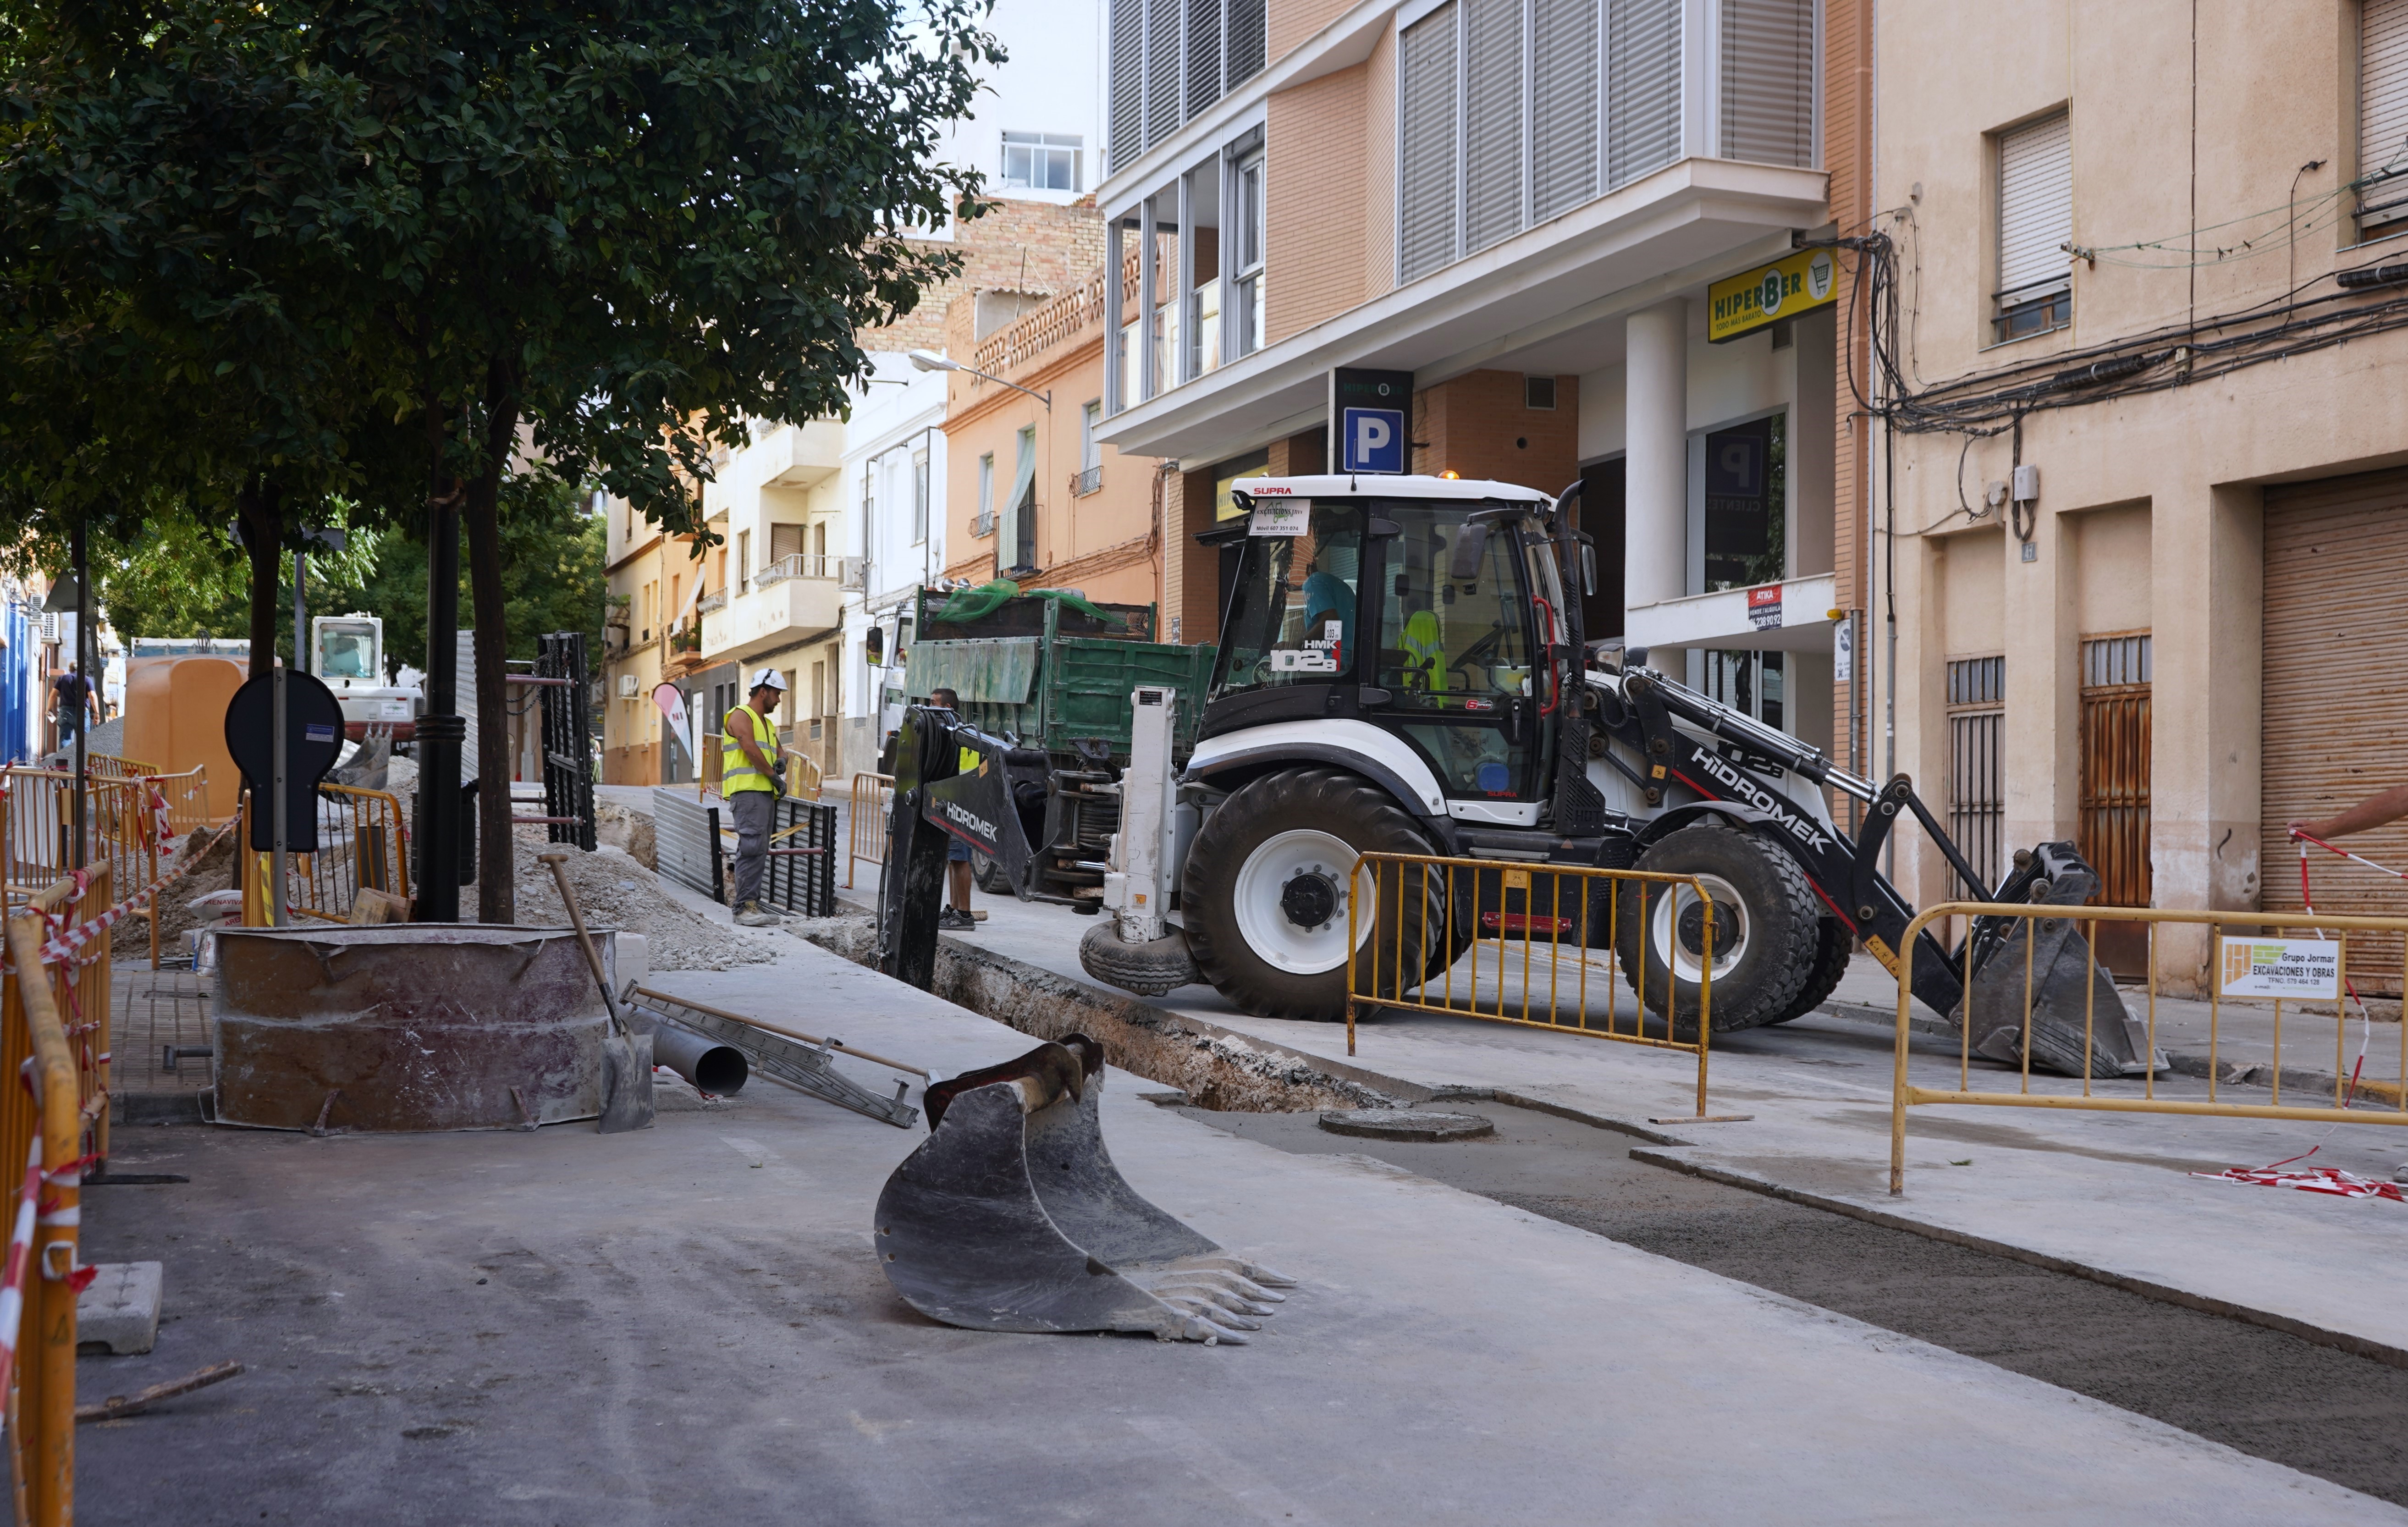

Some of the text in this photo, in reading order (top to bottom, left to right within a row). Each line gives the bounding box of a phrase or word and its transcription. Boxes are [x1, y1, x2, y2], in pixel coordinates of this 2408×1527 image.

[1715, 272, 1801, 320] HIPERBER
[1716, 321, 1729, 331] TODO
[1742, 310, 1761, 323] BARATO
[1358, 417, 1390, 463] P
[1757, 590, 1773, 601] ATIKA
[1305, 640, 1337, 649] HMK
[1576, 810, 1602, 821] HOT
[2282, 953, 2335, 964] Grupo Jormar
[2253, 965, 2335, 977] EXCAVACIONES Y OBRAS
